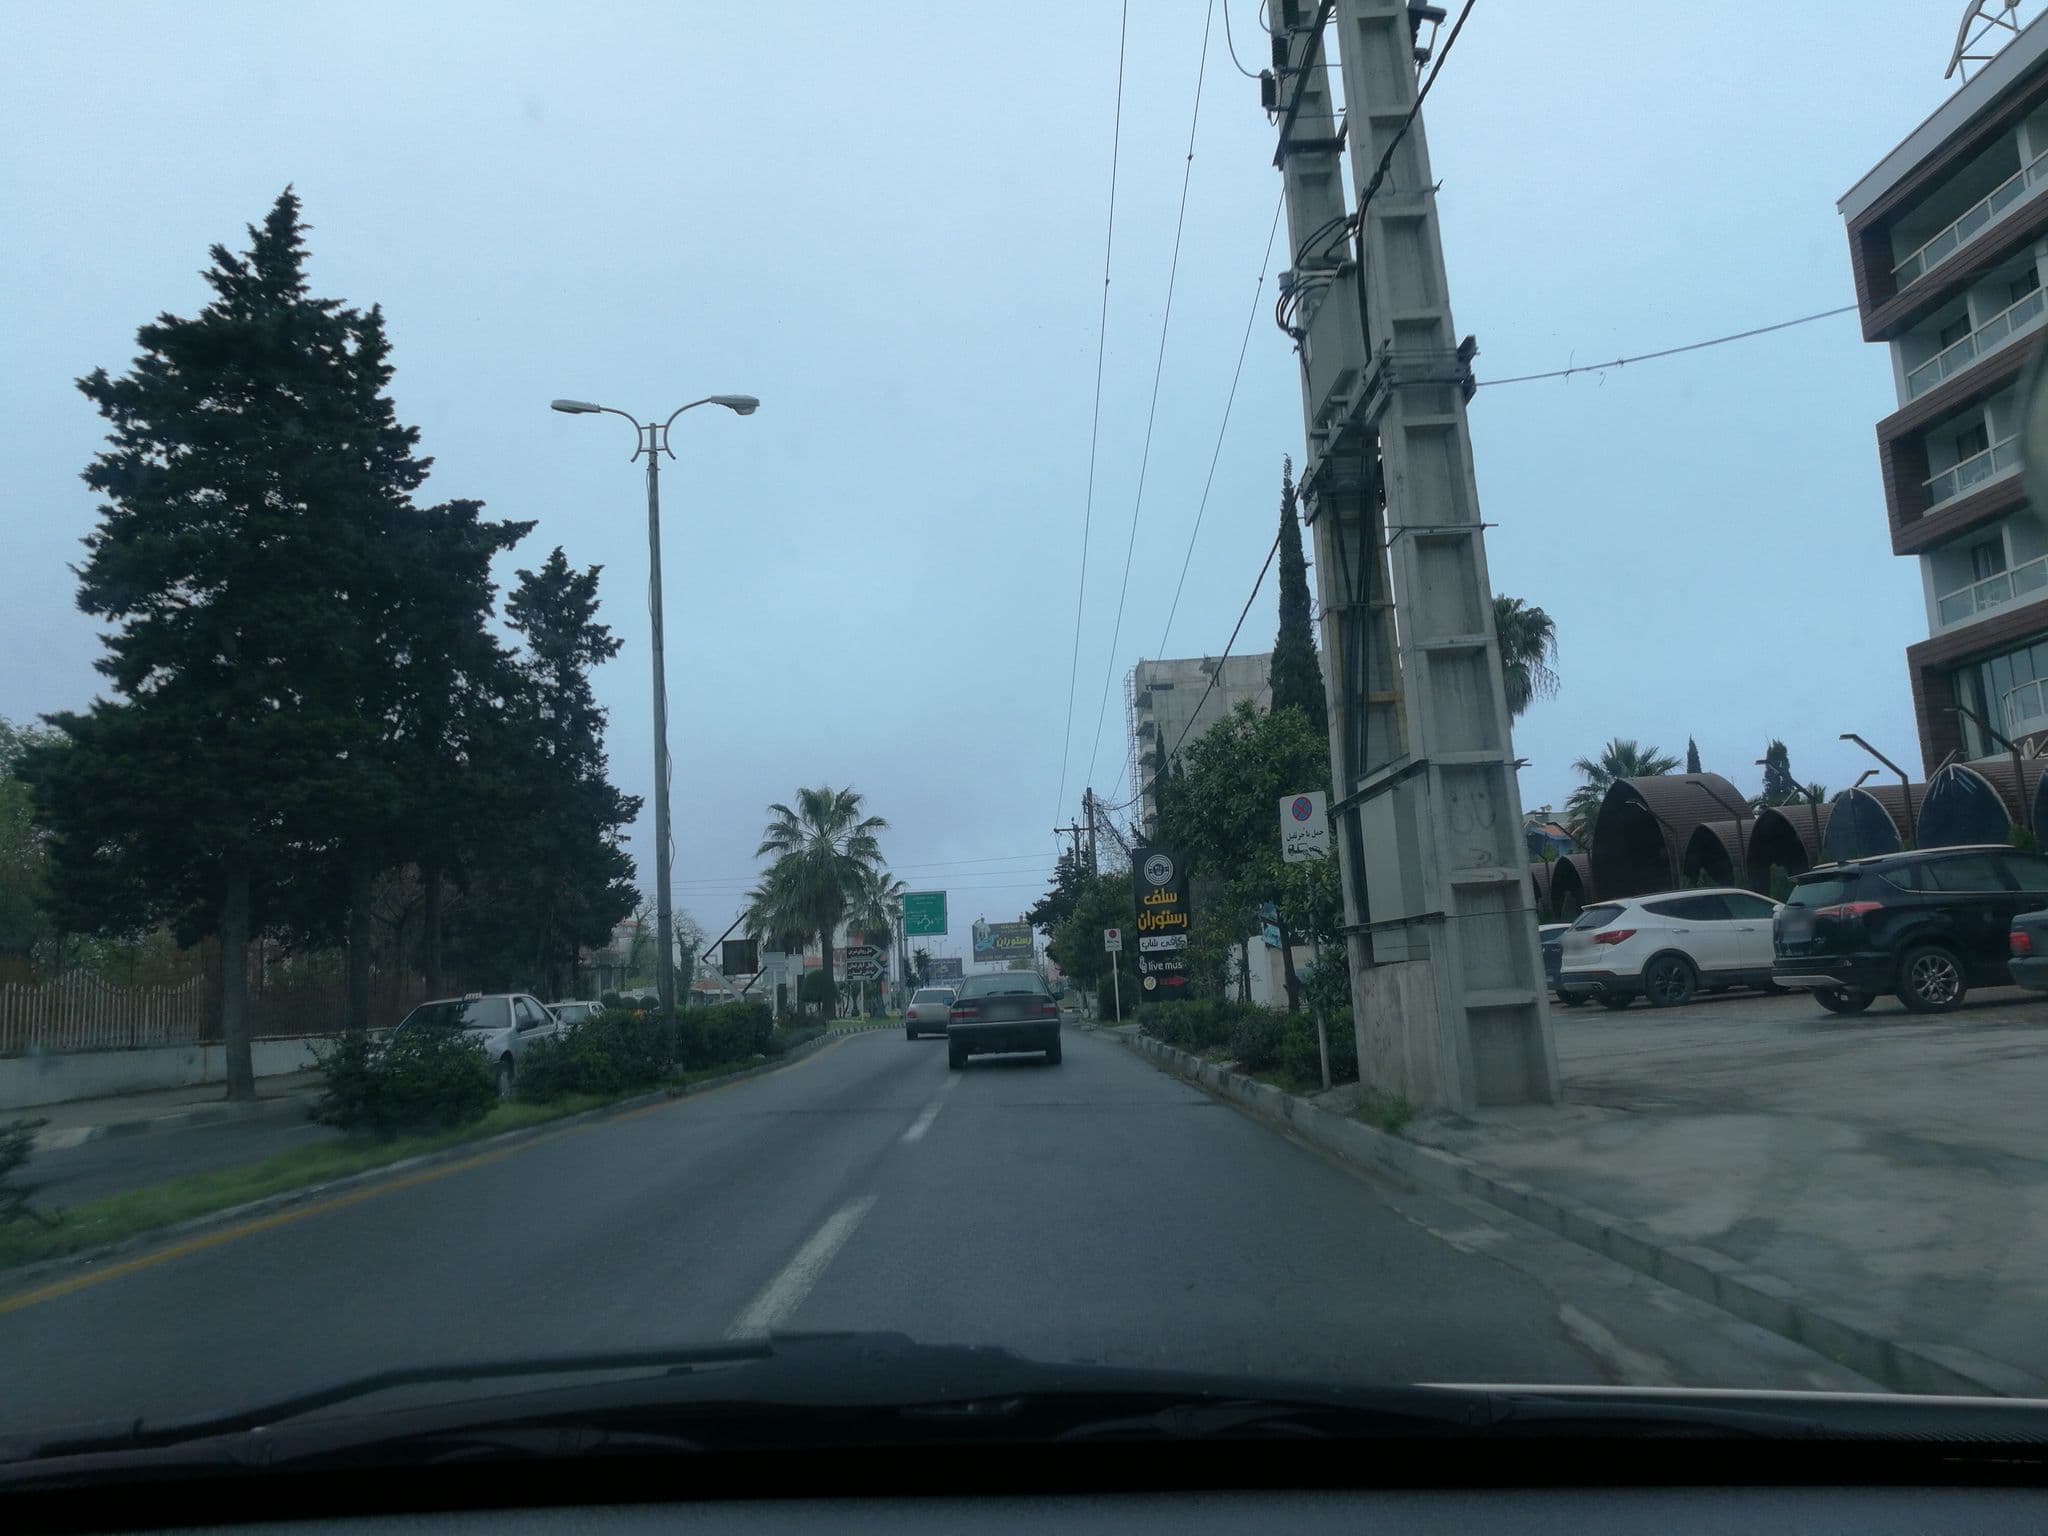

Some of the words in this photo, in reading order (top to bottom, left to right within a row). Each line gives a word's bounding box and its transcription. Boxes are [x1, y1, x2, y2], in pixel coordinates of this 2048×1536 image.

[1144, 888, 1178, 905] سلف
[1138, 910, 1188, 931] رستوران
[996, 936, 1032, 949] رستوران
[1148, 961, 1164, 971] live
[1165, 962, 1184, 970] mus
